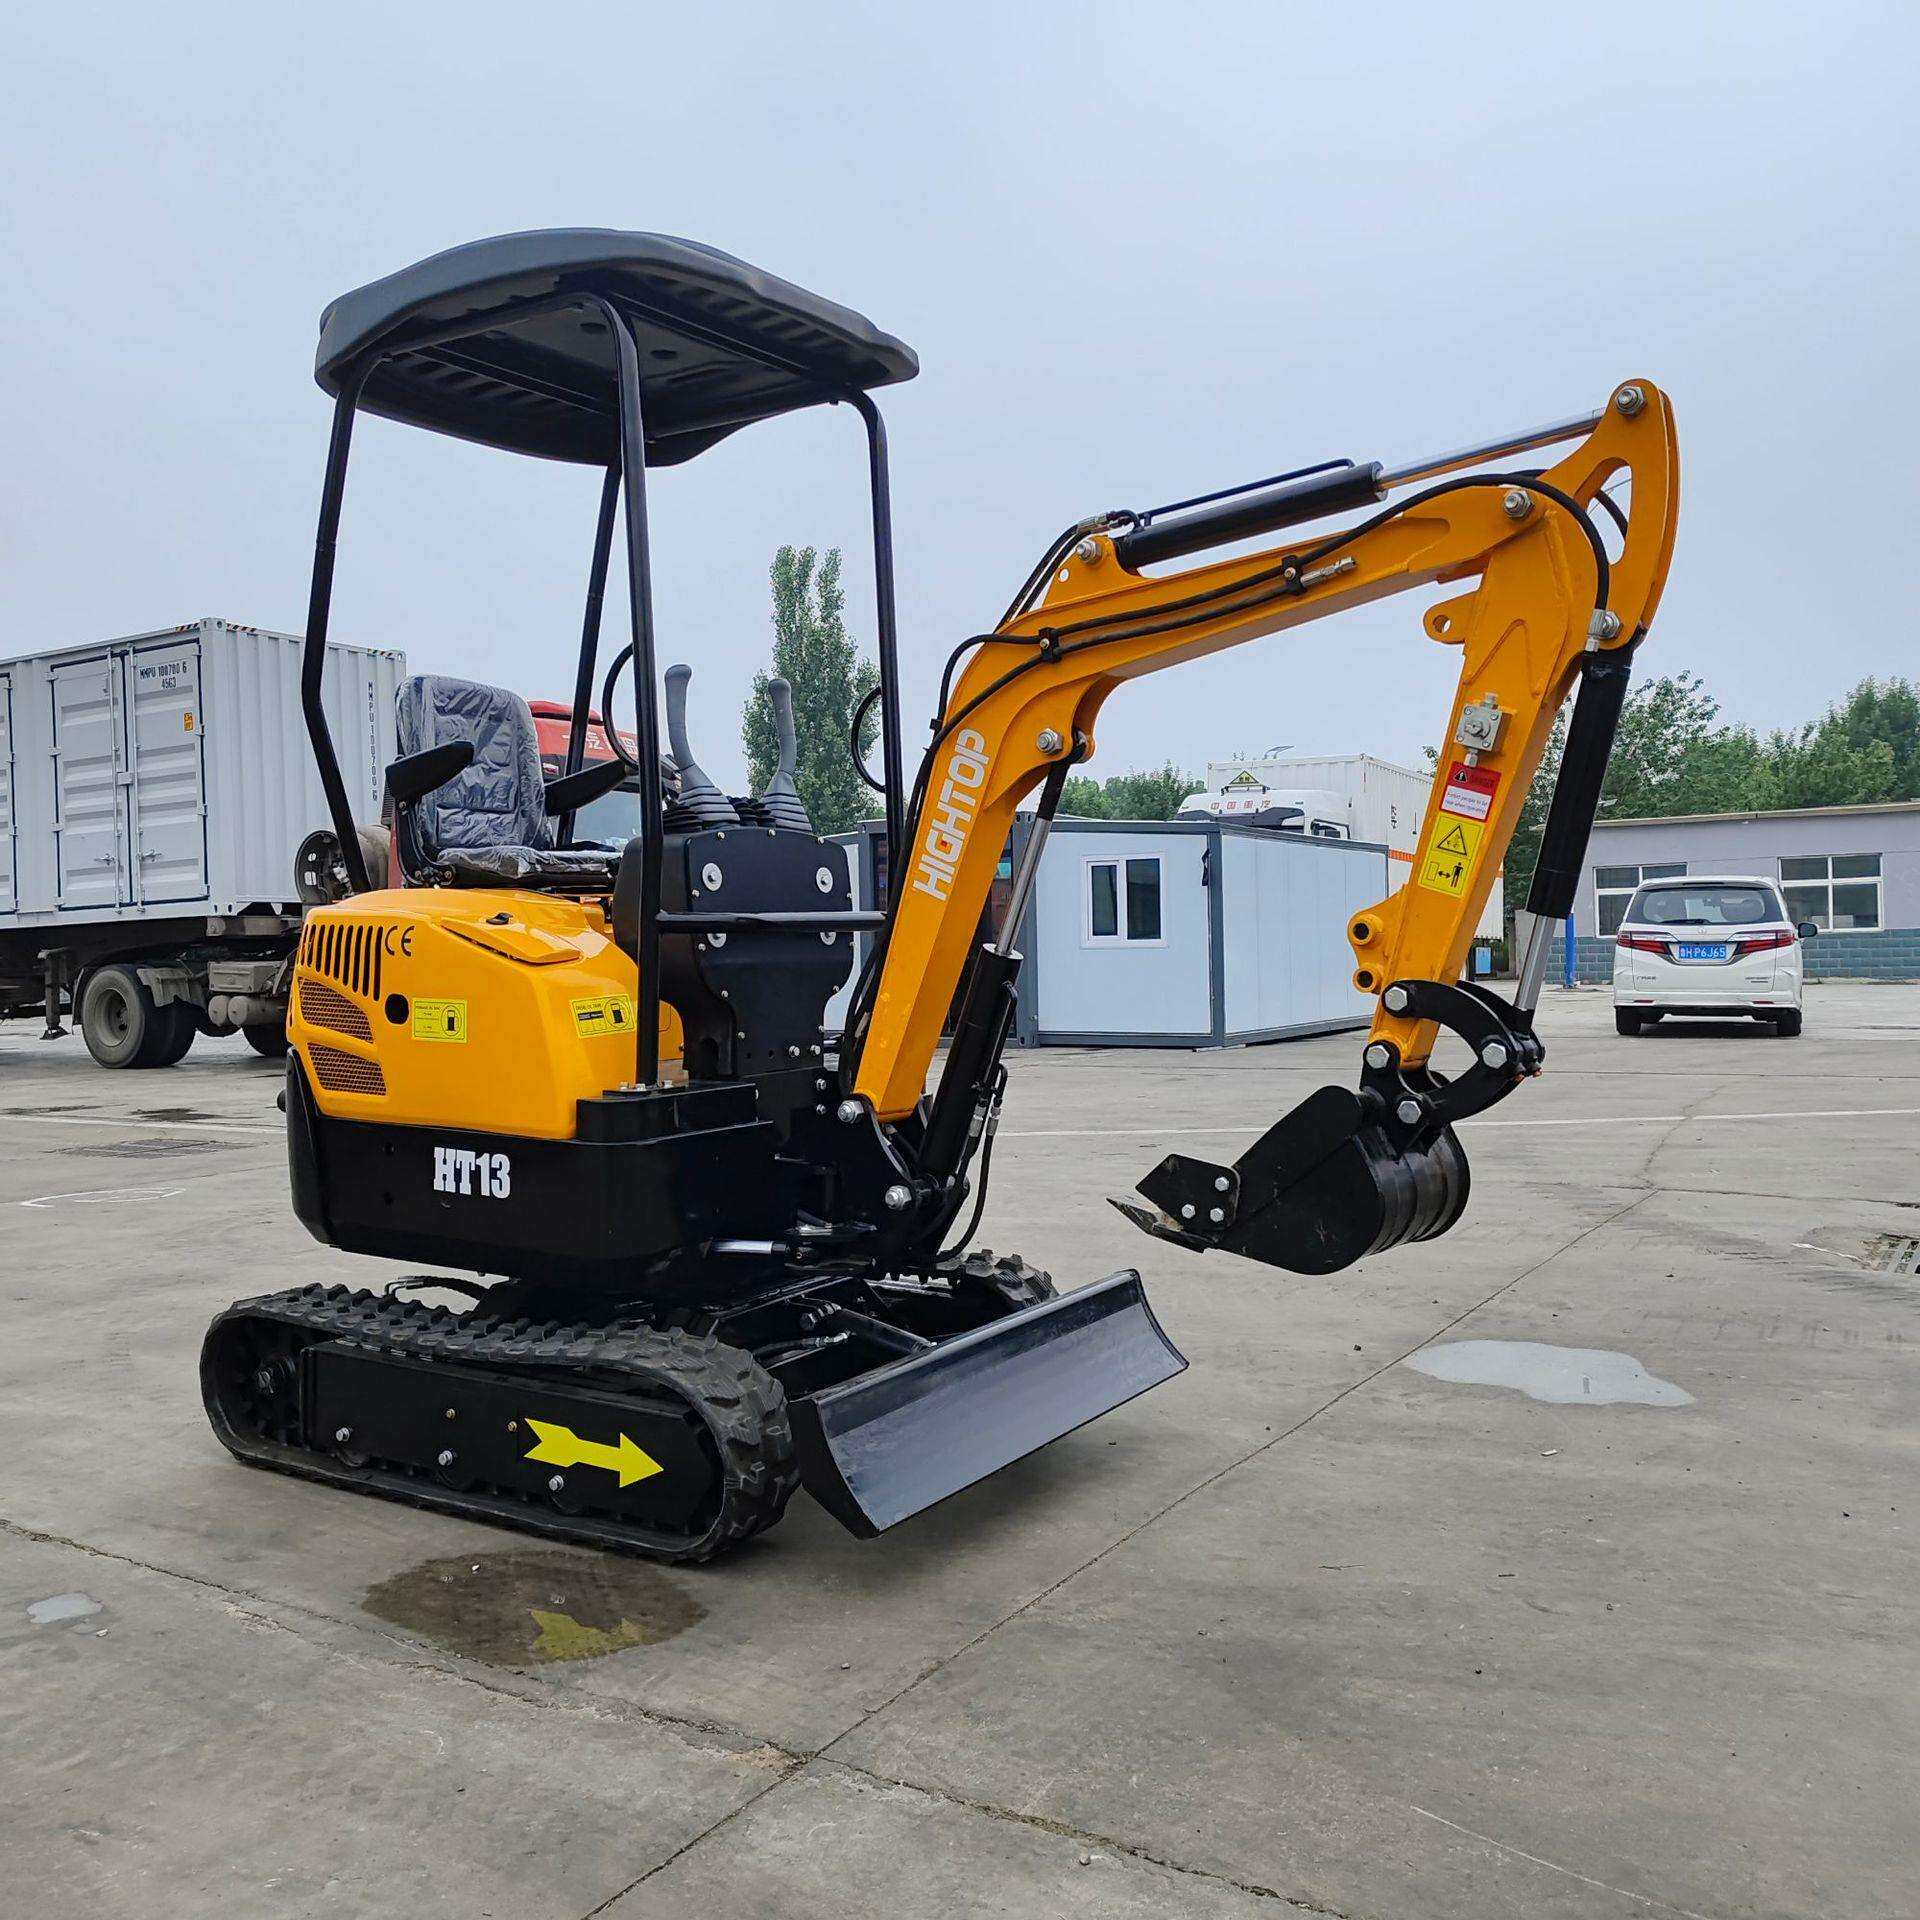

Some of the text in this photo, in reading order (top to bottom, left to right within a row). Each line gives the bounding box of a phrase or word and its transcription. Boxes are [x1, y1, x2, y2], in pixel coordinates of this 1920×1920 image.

[182, 661, 187, 673] 6
[913, 727, 990, 901] HIGHTOP
[384, 925, 415, 957] CE
[433, 1146, 511, 1199] HT13
